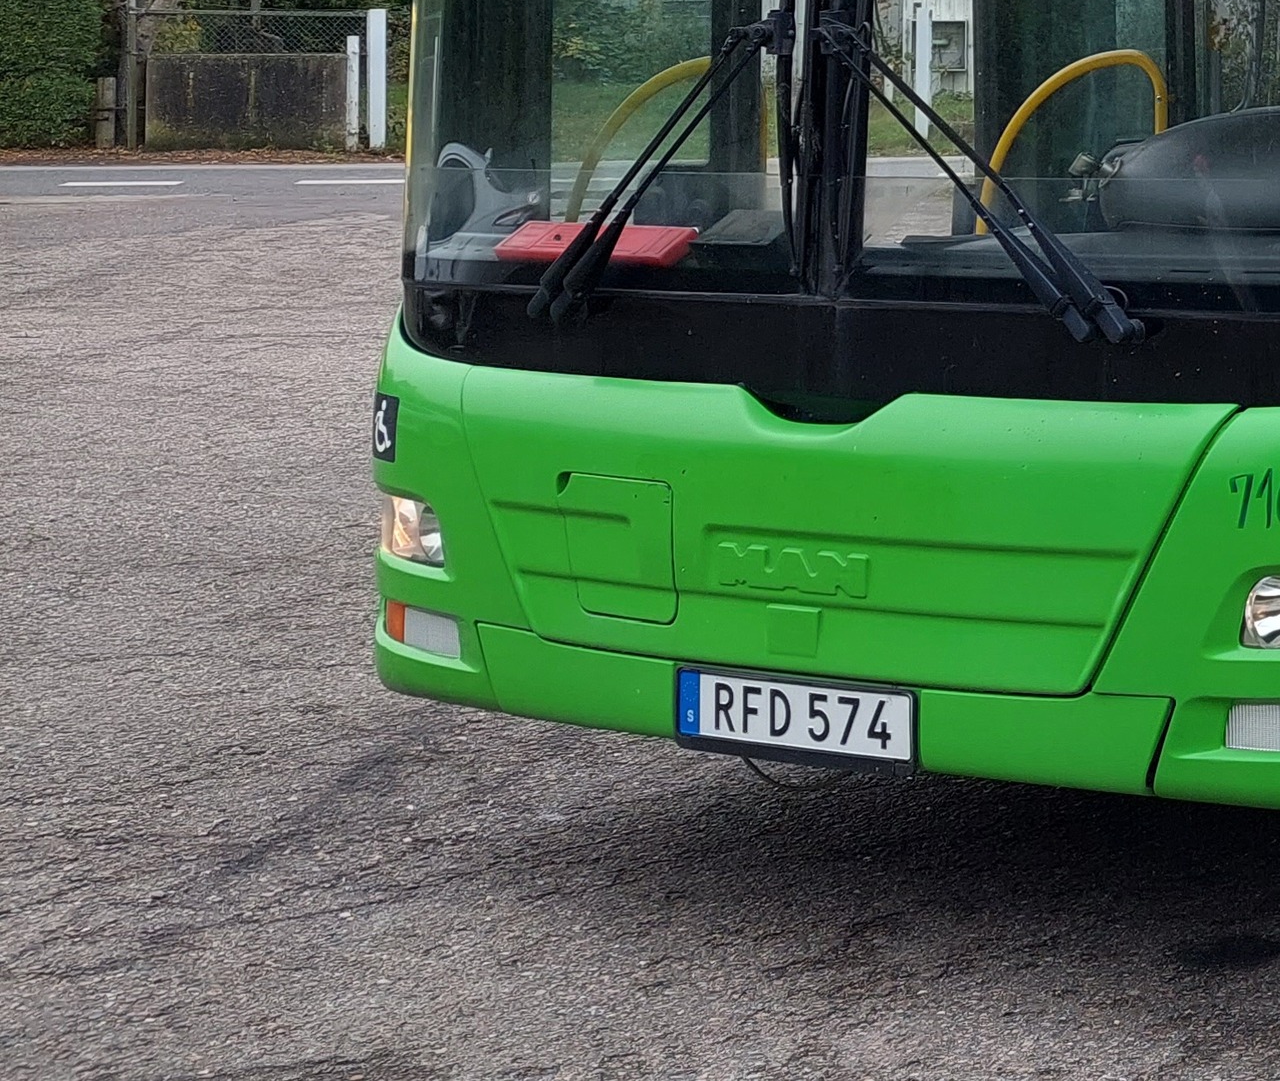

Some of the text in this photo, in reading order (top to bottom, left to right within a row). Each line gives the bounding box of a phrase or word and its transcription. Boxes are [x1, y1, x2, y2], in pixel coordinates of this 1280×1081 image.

[718, 541, 870, 599] MAN
[686, 709, 694, 722] S
[714, 682, 892, 750] RFD 574
